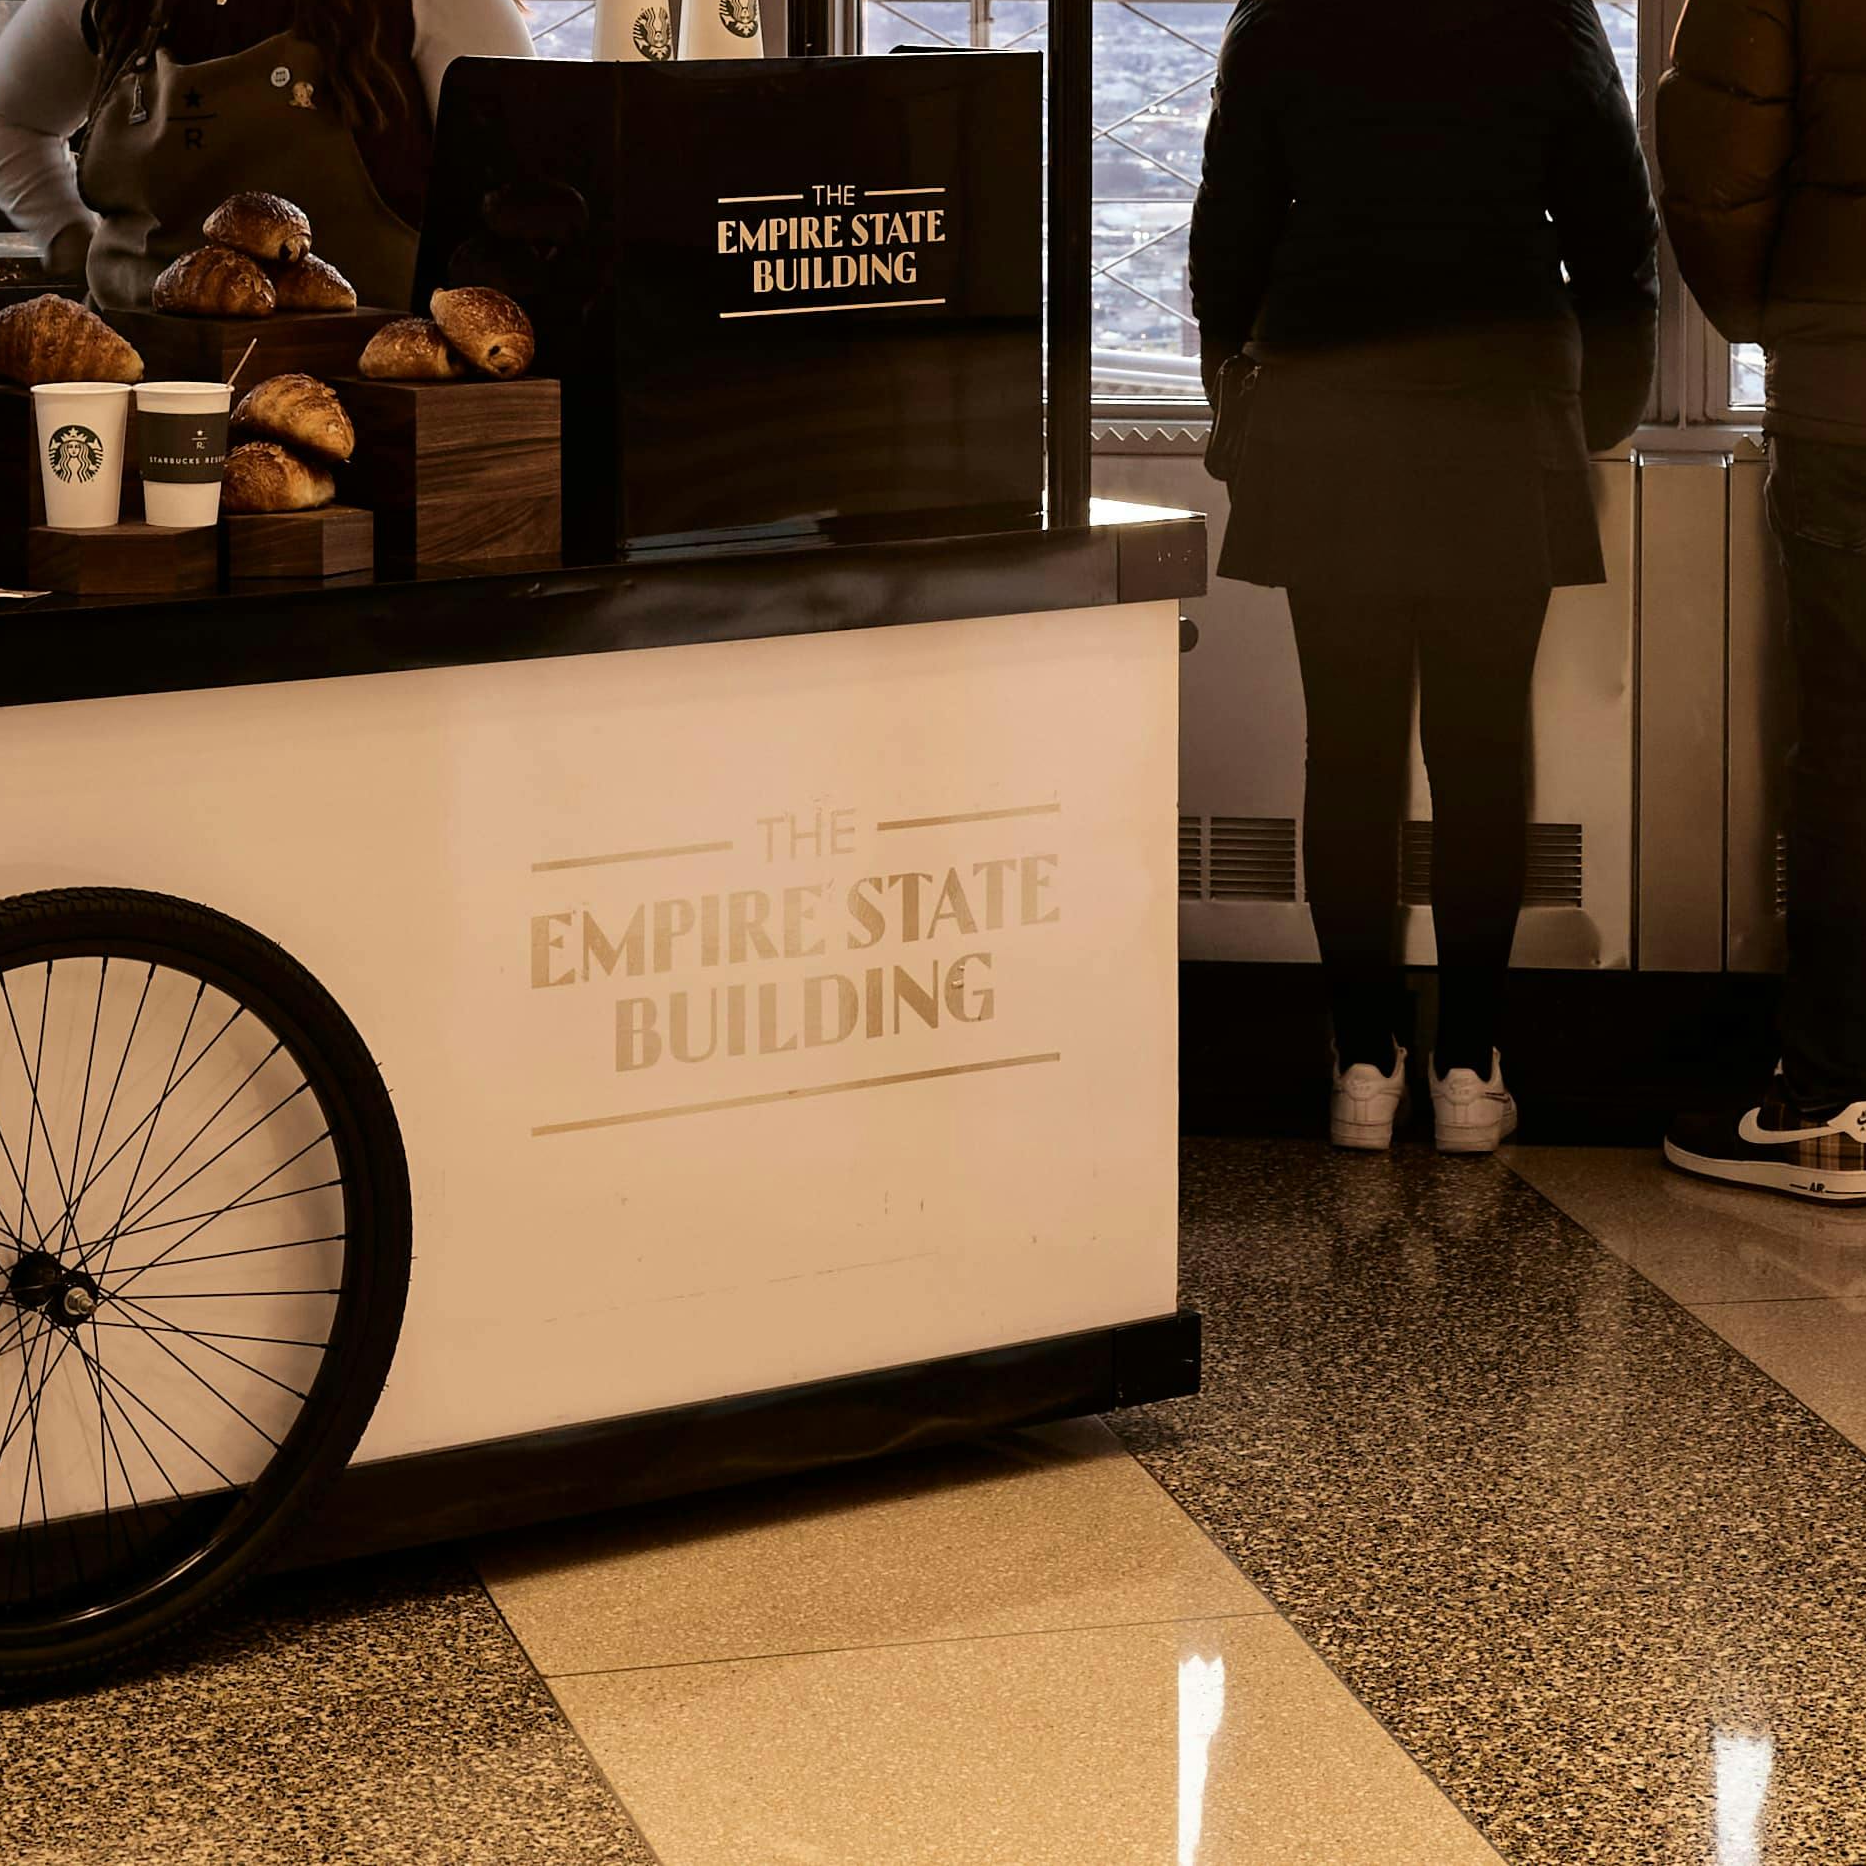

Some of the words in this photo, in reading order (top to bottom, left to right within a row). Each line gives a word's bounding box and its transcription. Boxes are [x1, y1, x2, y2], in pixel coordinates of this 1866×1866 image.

[812, 184, 856, 206] THE
[718, 215, 843, 254] EMPIRE
[851, 210, 946, 246] STATE
[754, 251, 917, 293] BUILDING
[149, 456, 199, 464] STARBUCKS
[757, 806, 857, 863] THE
[531, 884, 827, 989] EMPIRE
[846, 854, 1061, 951] STATE
[615, 952, 995, 1073] BUILDING
